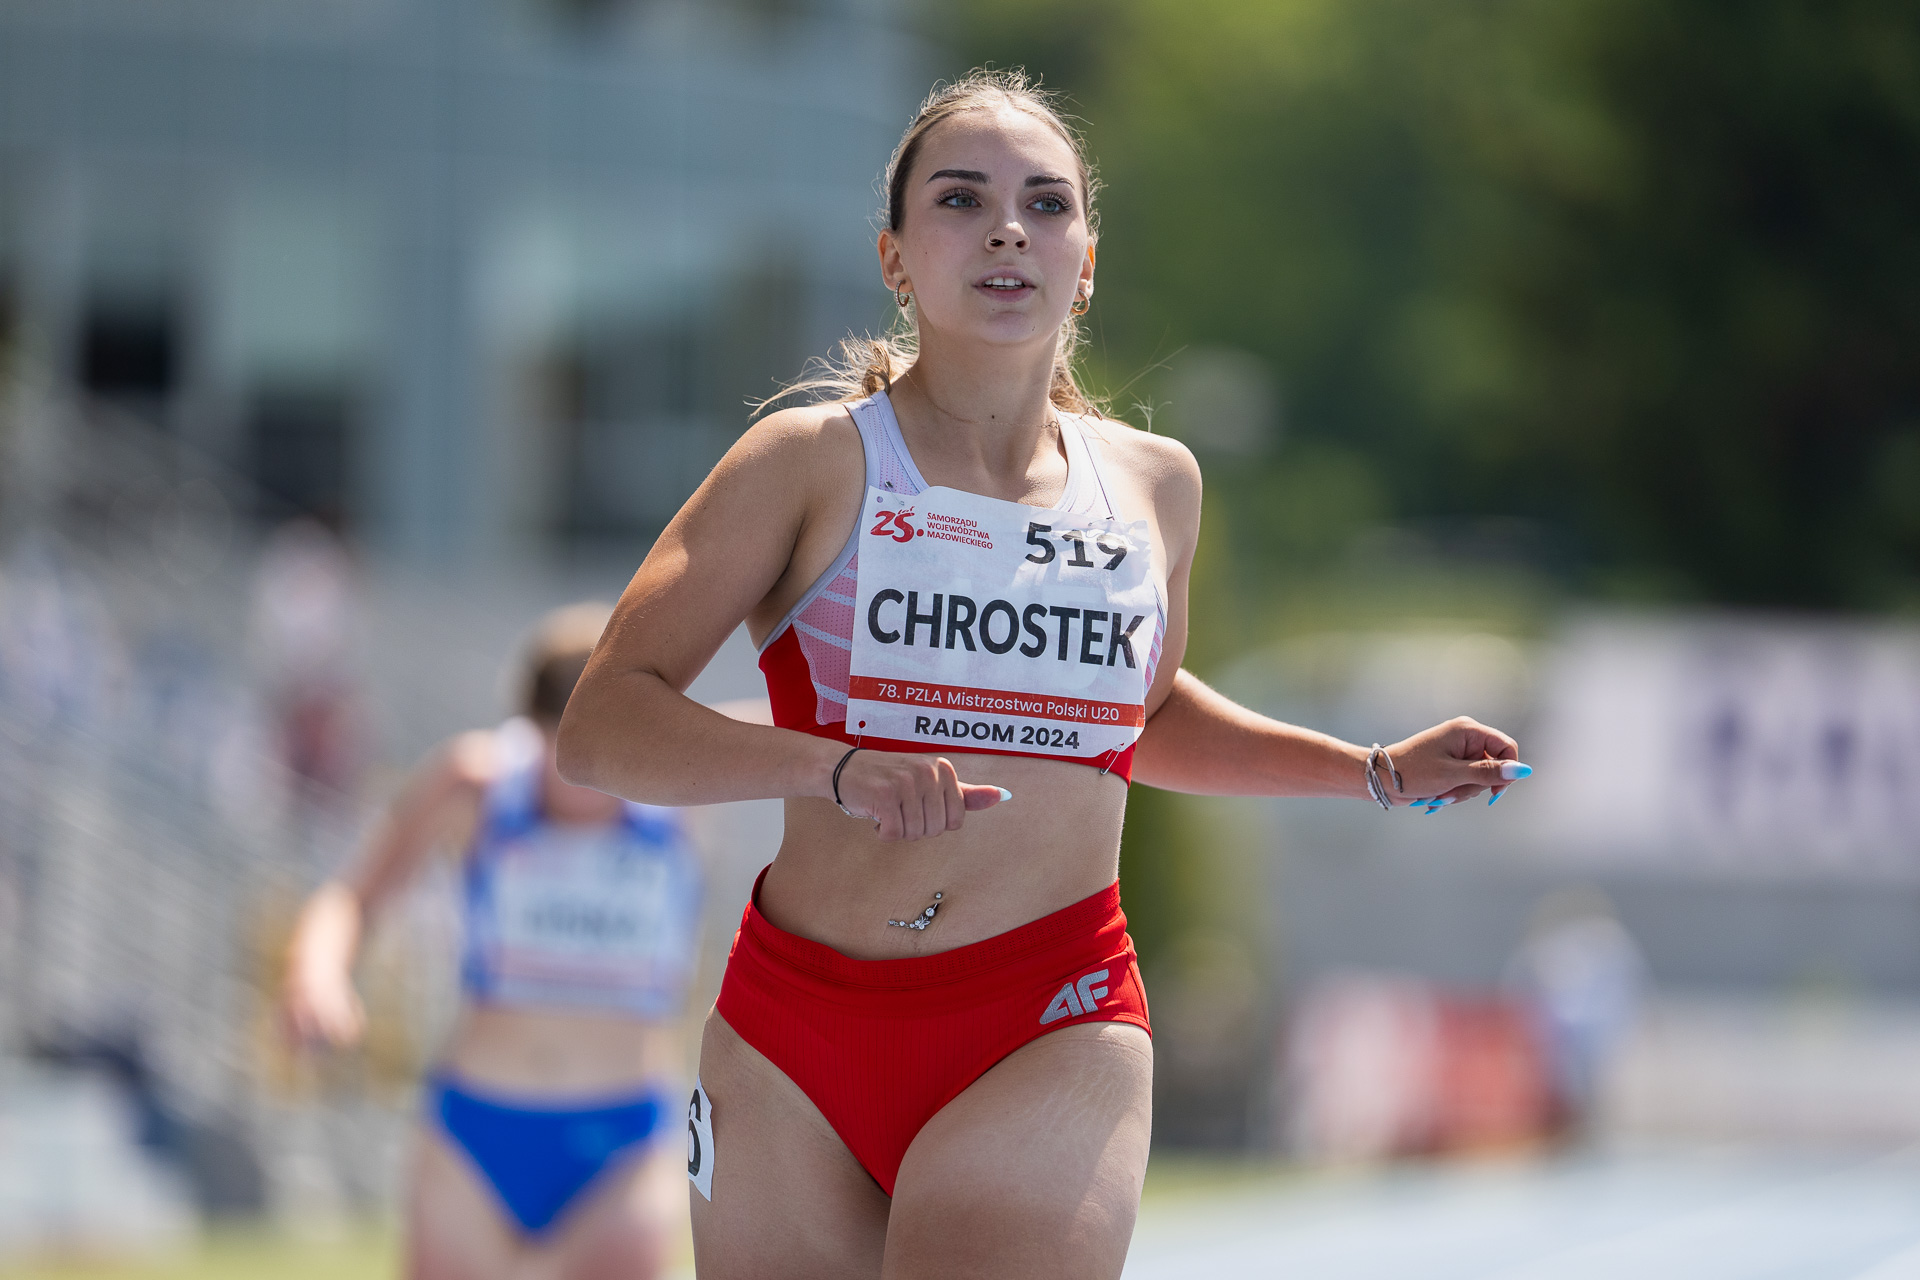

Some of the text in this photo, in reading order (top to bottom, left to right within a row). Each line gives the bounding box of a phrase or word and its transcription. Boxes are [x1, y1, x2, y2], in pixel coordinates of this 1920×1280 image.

[926, 512, 978, 528] SAMORZĄDU
[926, 521, 990, 540] WOJEWÓDZTWA
[926, 530, 994, 549] MAZOWIECKIEGO
[1025, 521, 1127, 571] 519
[867, 588, 1145, 669] CHROSTEK
[877, 683, 1120, 721] 78. PZLA Mistrzostwa Polski U20
[914, 715, 1080, 750] RADOM 2024
